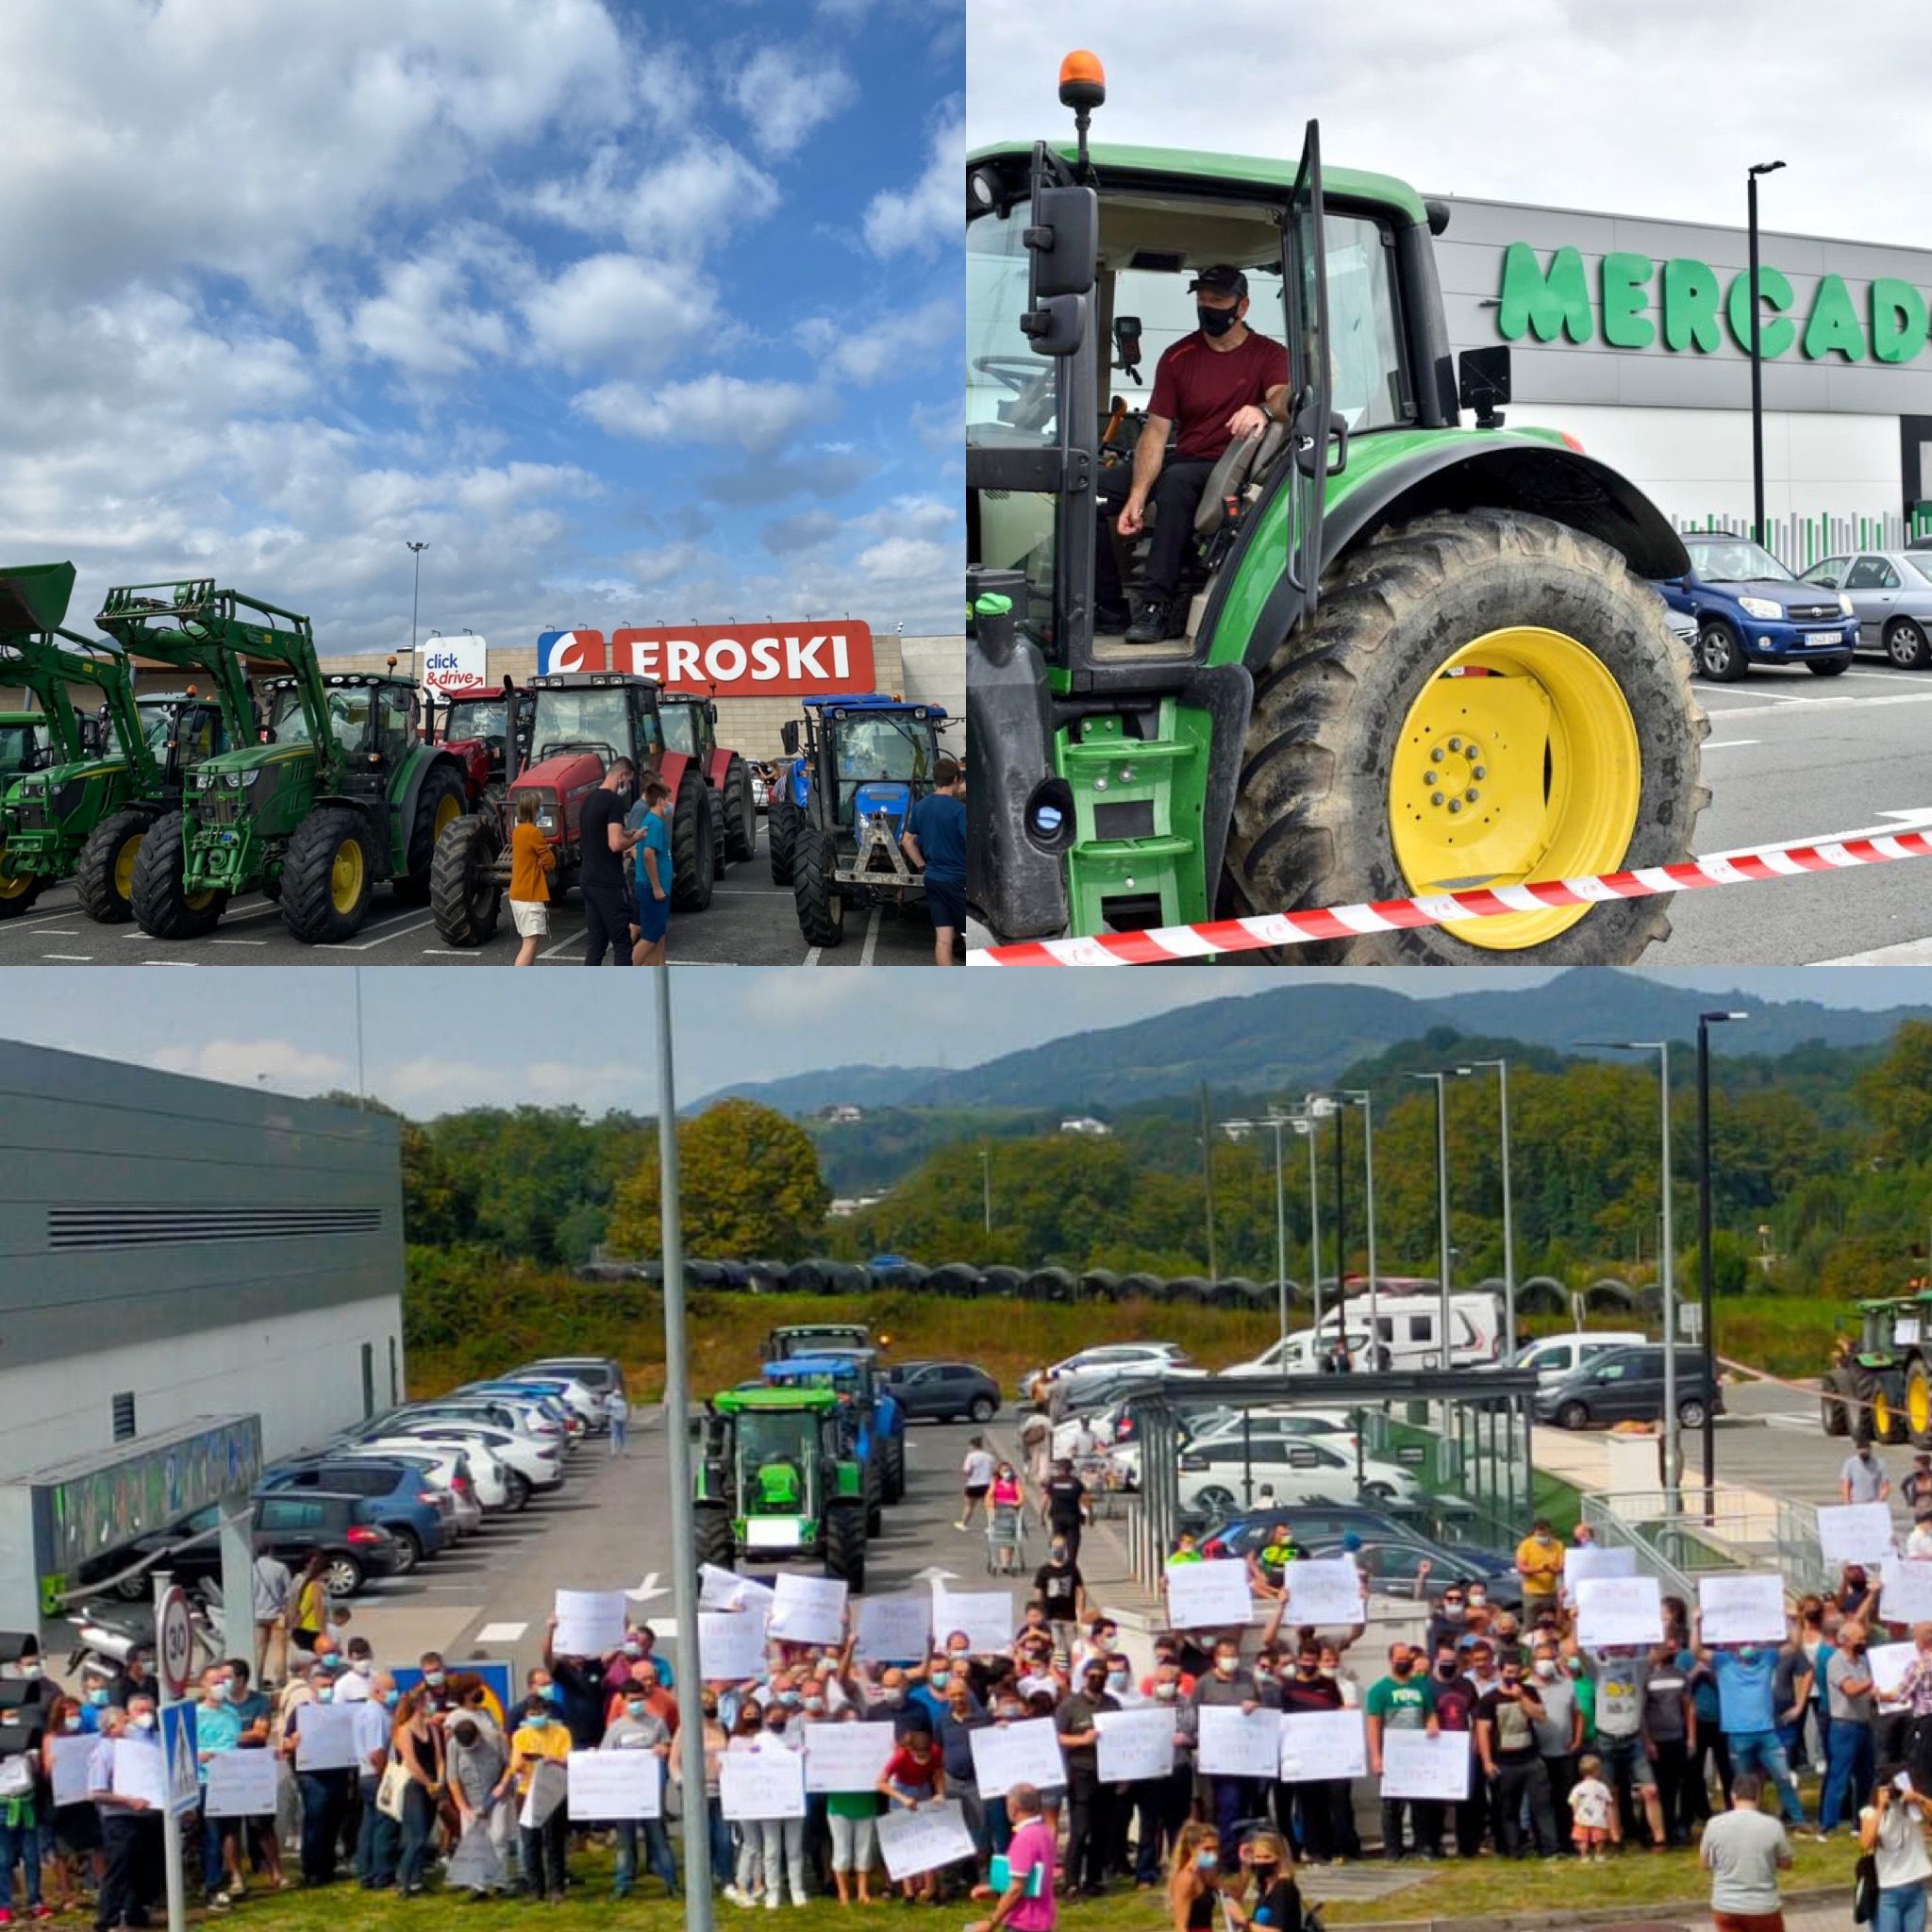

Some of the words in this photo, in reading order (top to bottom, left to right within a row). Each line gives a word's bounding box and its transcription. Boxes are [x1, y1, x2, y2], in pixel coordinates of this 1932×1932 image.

[1499, 242, 1932, 364] MERCAD
[426, 654, 458, 669] click
[630, 636, 850, 682] EROSKI
[170, 1623, 185, 1659] 30
